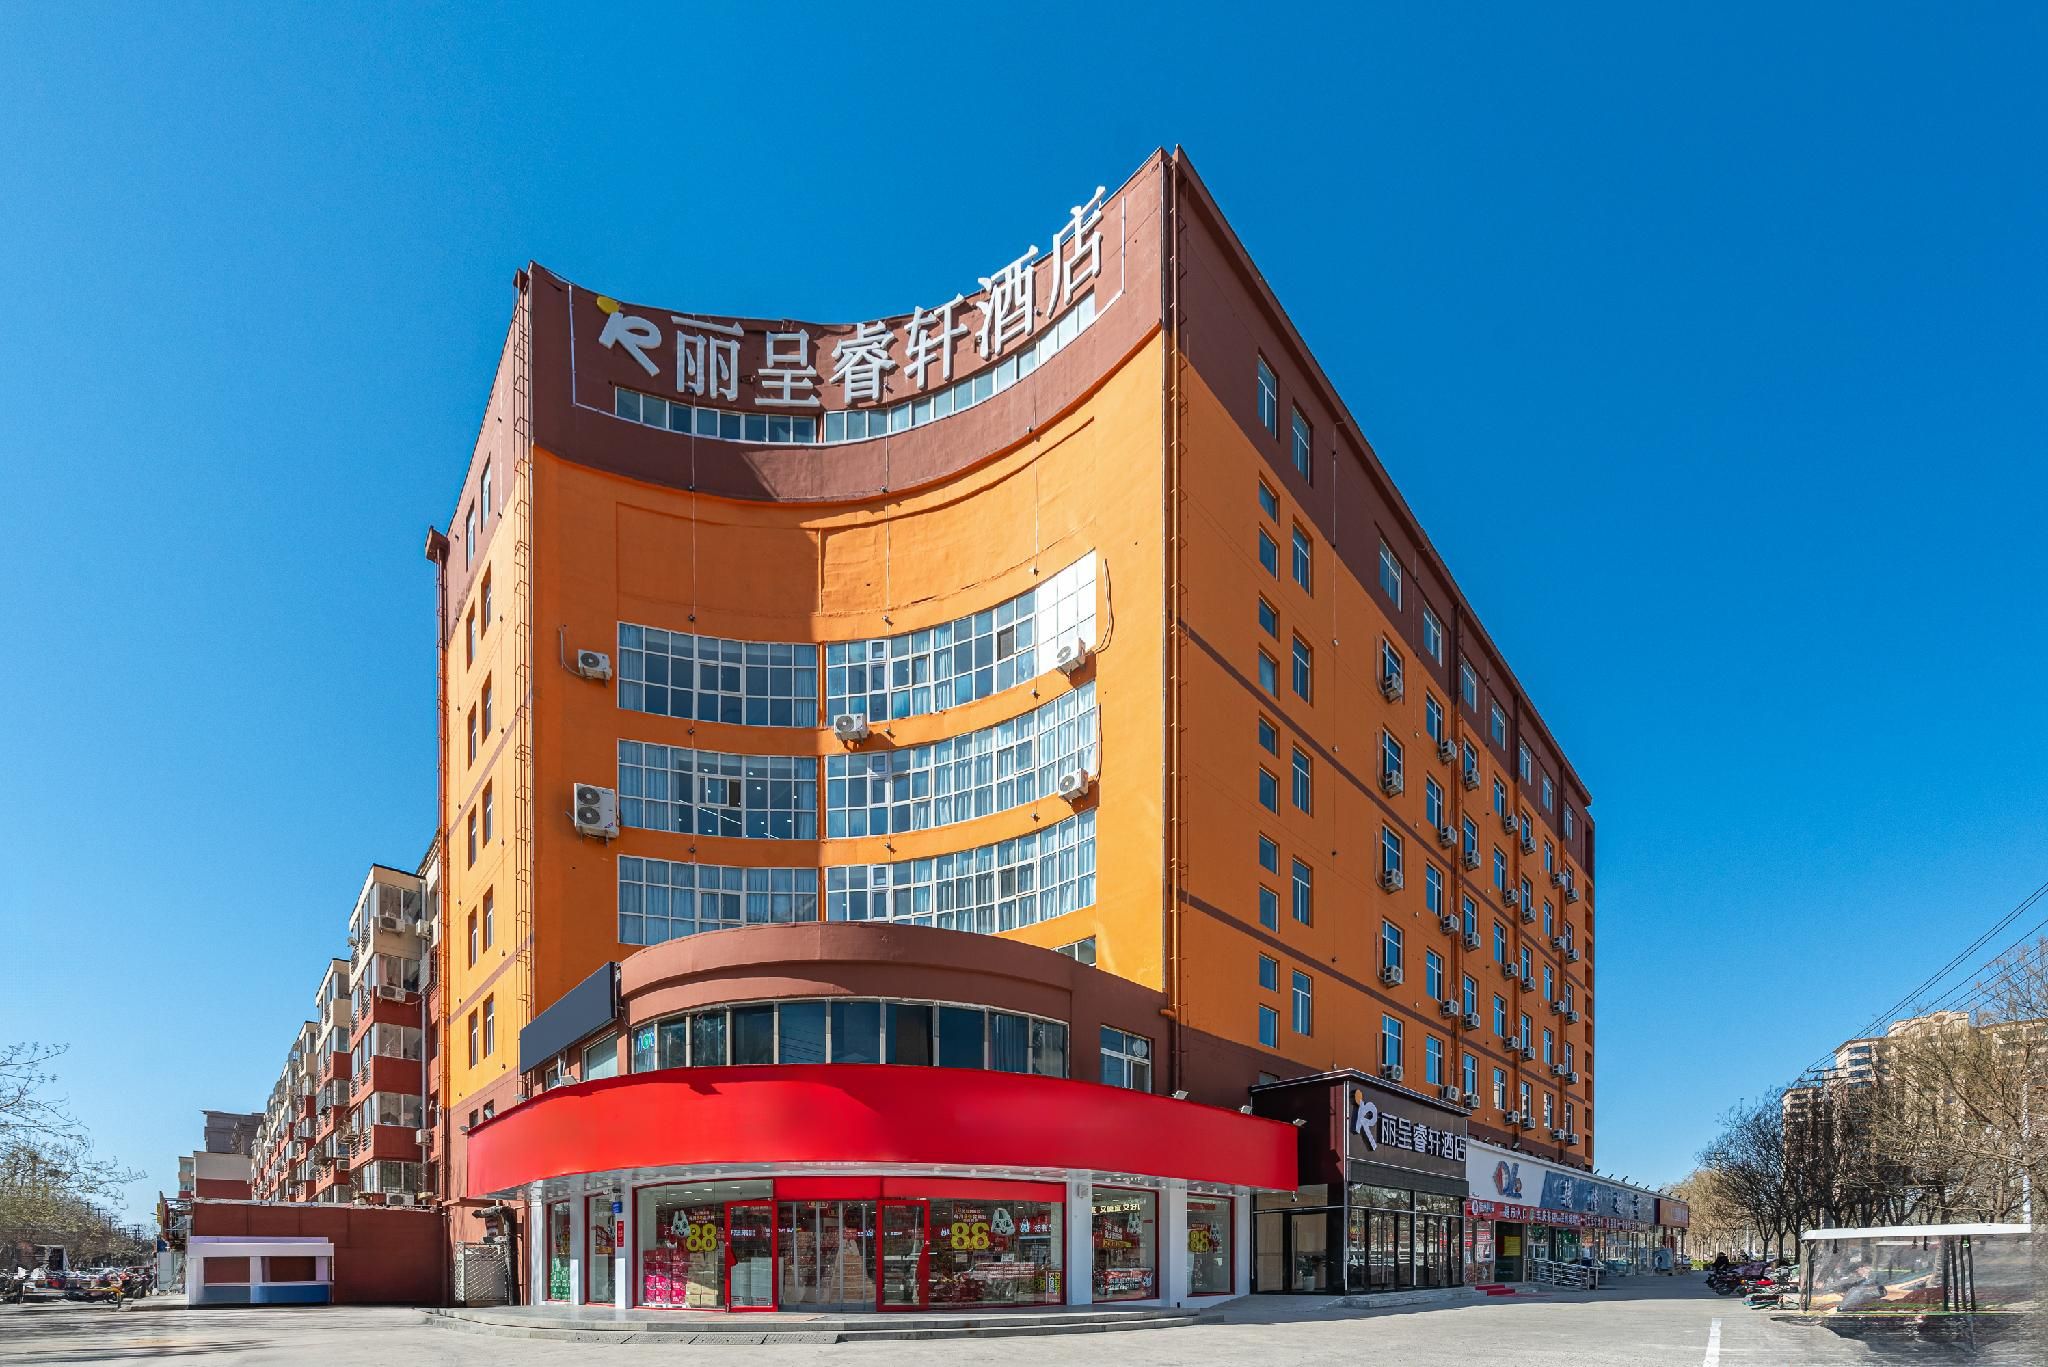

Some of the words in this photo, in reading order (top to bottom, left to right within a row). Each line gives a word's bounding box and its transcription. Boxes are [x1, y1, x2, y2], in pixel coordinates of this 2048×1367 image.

[671, 186, 1106, 408] 丽呈睿轩酒店
[1381, 1112, 1466, 1162] 丽呈睿轩酒店
